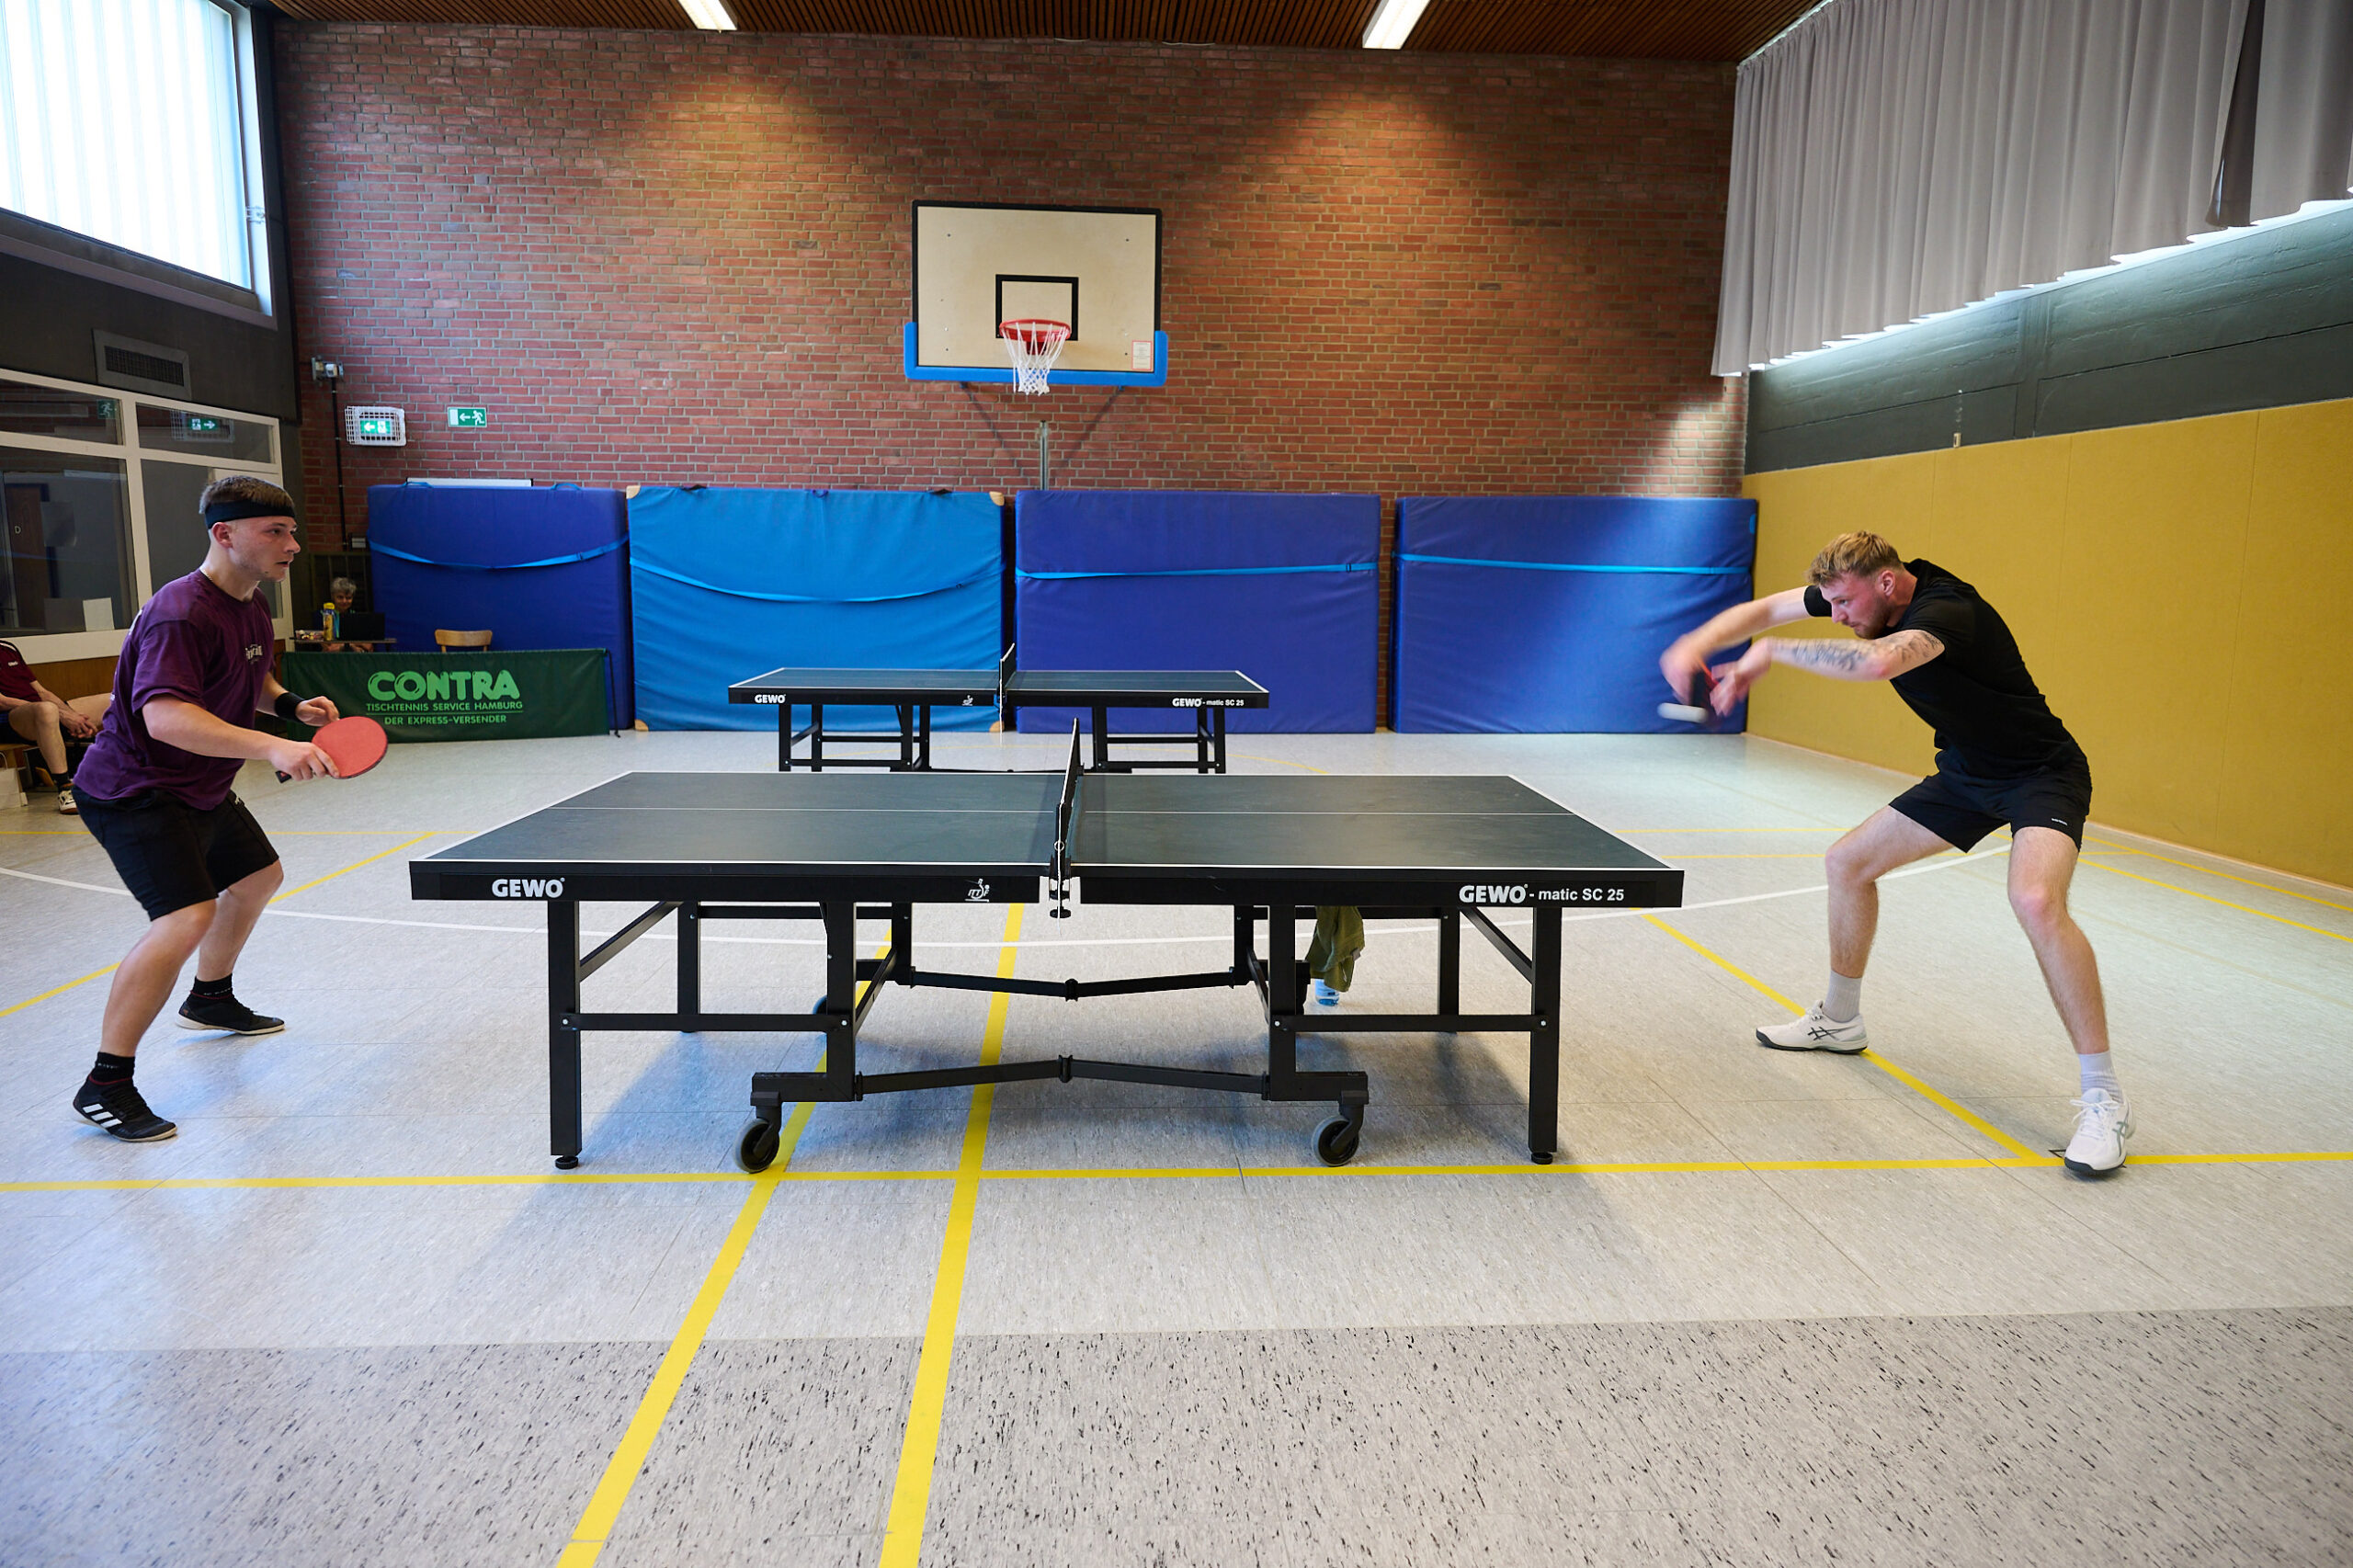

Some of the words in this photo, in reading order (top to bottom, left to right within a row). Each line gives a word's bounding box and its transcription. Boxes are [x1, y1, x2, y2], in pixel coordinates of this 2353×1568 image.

[368, 669, 521, 701] CONTRA
[755, 694, 786, 704] GEWO
[1172, 698, 1202, 708] GEWO
[1225, 699, 1235, 707] SC
[1235, 699, 1245, 707] 25
[366, 702, 429, 711] TISCHTENNIS
[433, 702, 471, 711] SERVICE
[474, 700, 523, 710] HAMBURG
[384, 716, 404, 725] DER
[407, 715, 507, 725] EXPRESS-VERSENDER
[492, 879, 564, 899] GEWO
[1459, 884, 1528, 903] GEWO
[1538, 888, 1578, 901] matic
[1582, 888, 1603, 901] SC
[1607, 888, 1625, 902] 25
